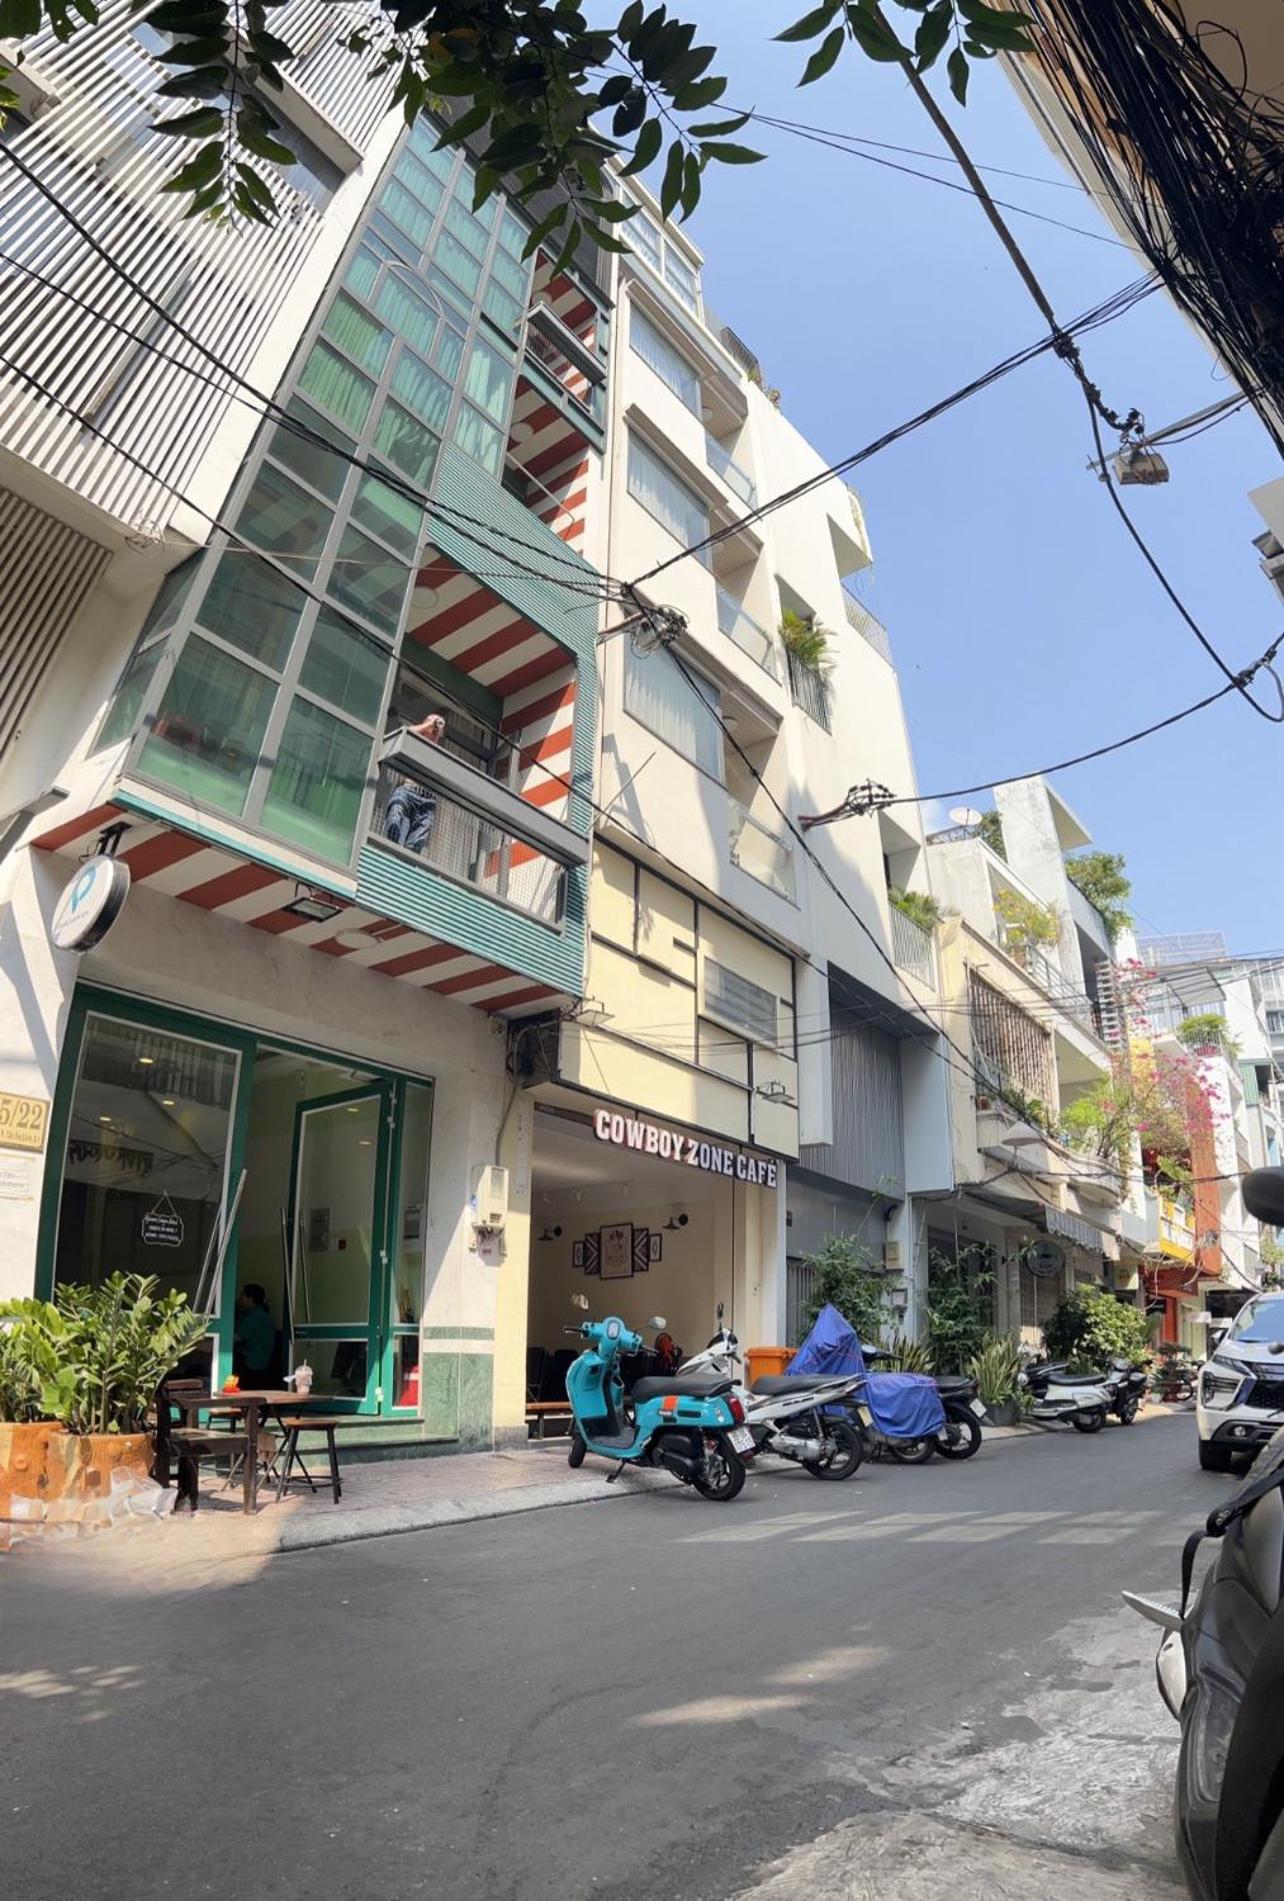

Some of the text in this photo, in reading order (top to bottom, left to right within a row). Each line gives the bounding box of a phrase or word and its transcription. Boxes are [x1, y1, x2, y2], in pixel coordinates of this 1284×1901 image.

[594, 1108, 778, 1188] COWBOY ZONE CAFÉ
